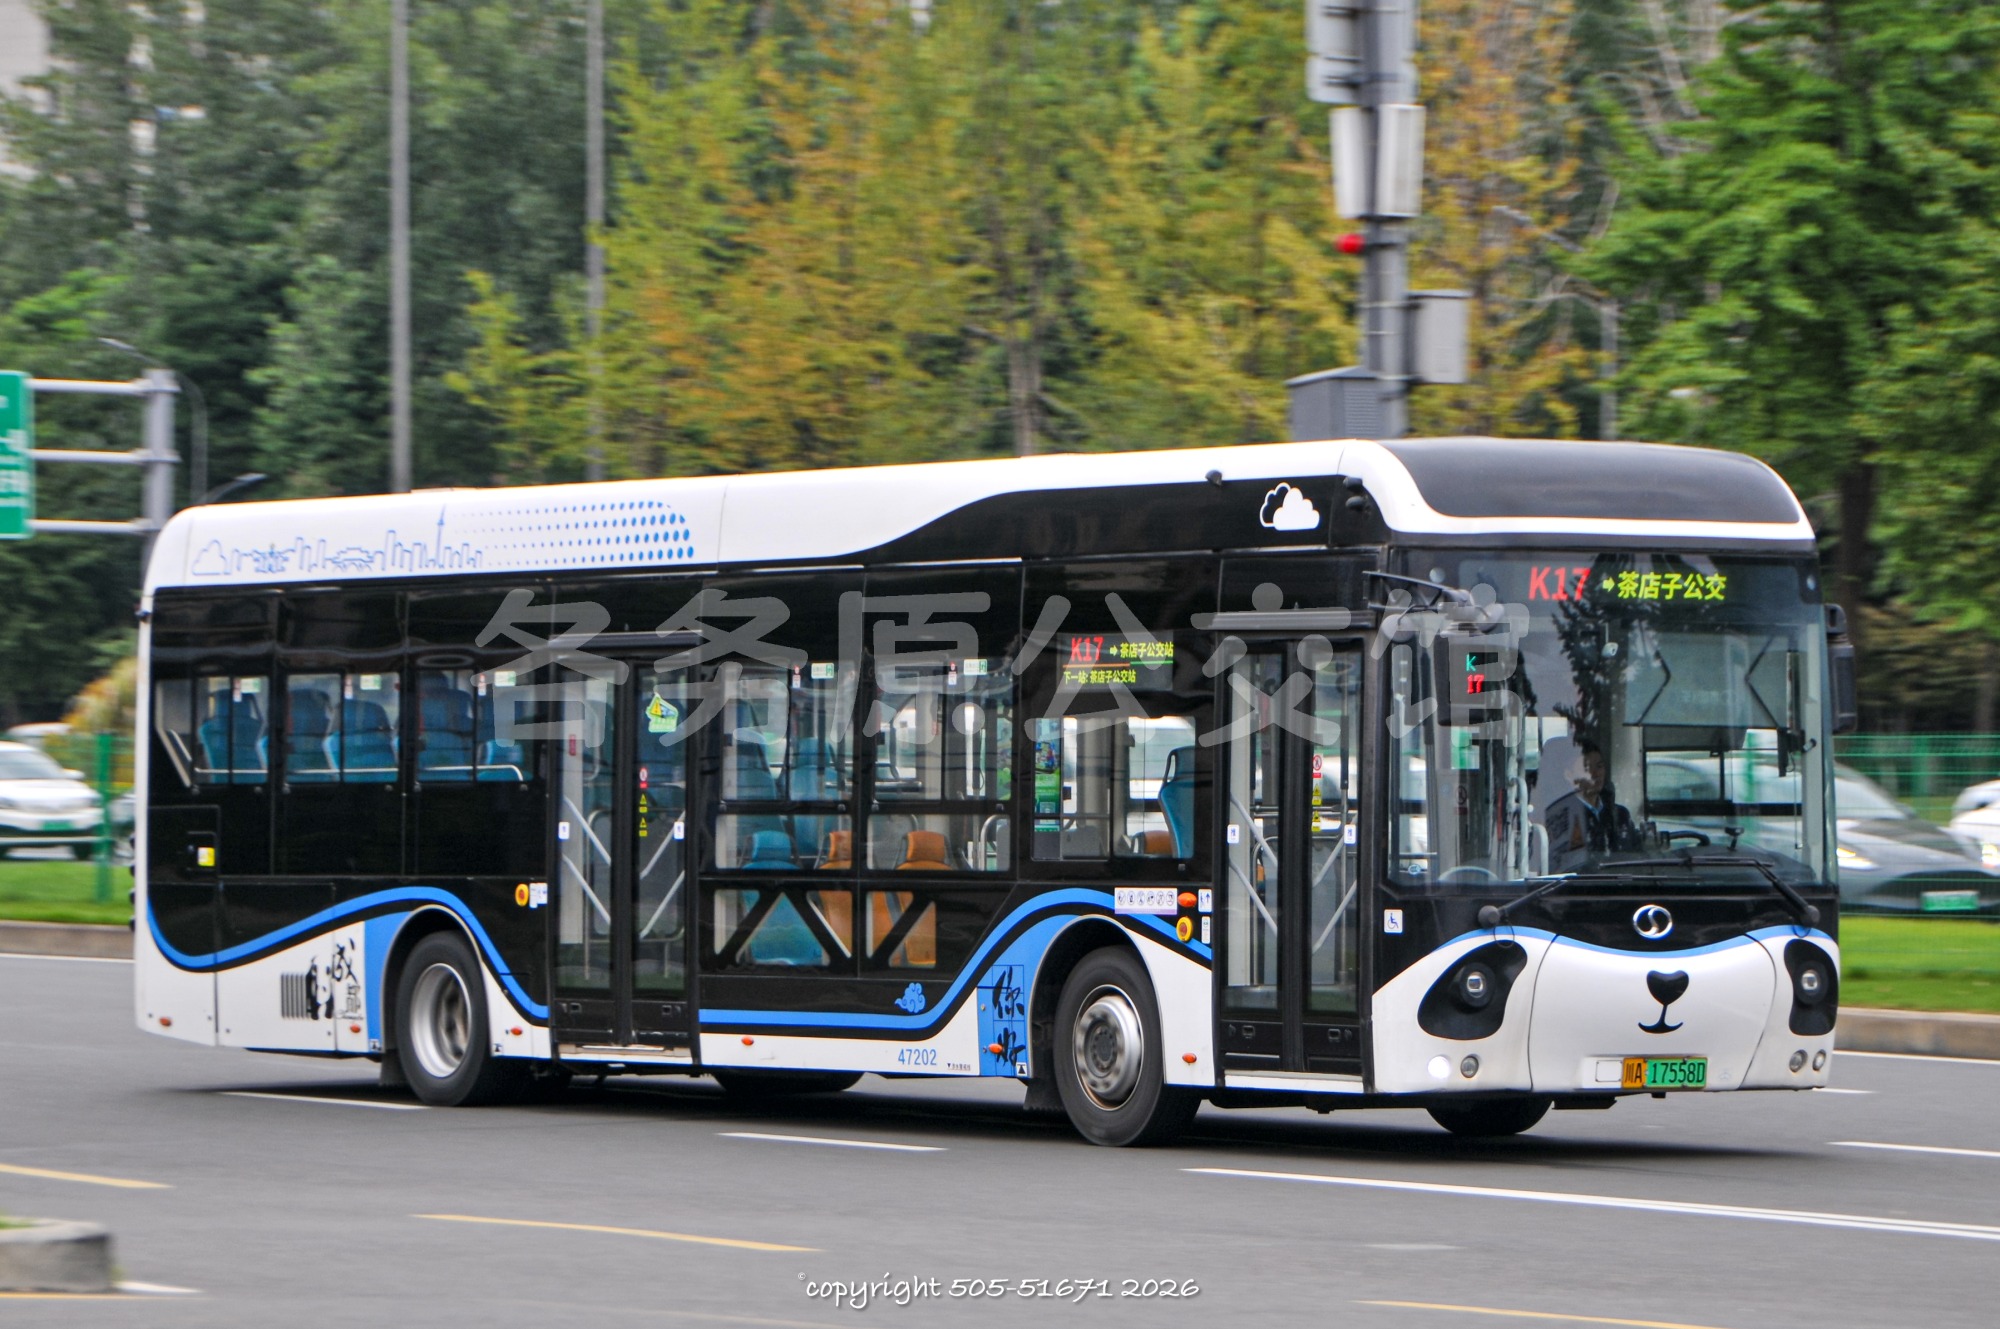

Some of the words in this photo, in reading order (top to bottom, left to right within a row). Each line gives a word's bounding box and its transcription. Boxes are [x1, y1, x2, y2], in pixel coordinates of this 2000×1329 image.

[1528, 566, 1592, 601] K17
[1617, 571, 1727, 600] 茶店子公交
[1071, 636, 1104, 662] K17
[1120, 641, 1174, 659] 茶店子公交站
[1467, 674, 1485, 694] 17
[992, 966, 1026, 1068] 你好
[898, 1048, 937, 1066] 47202
